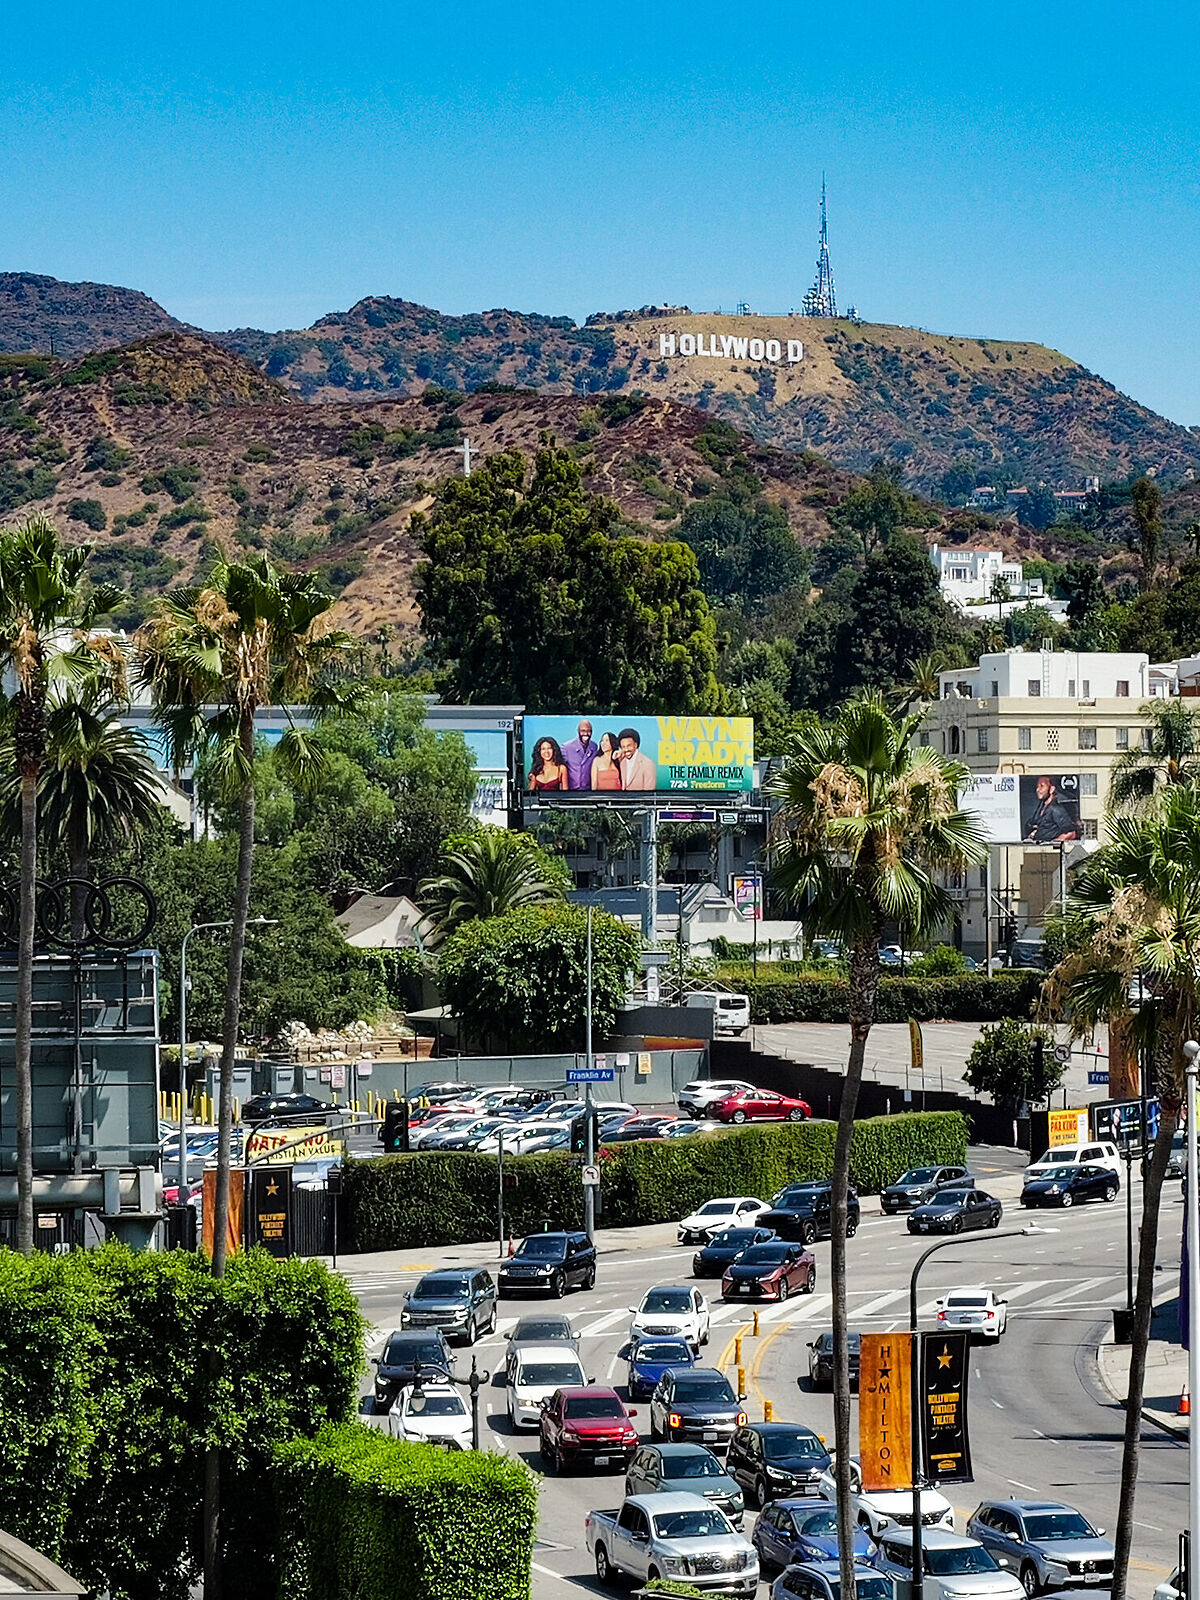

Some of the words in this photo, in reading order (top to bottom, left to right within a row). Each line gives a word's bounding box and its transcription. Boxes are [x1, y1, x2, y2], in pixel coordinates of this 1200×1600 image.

[659, 333, 804, 363] HOLLYWOOD
[497, 720, 512, 729] 192
[656, 715, 754, 741] WAYNE
[669, 766, 685, 779] THE
[687, 766, 716, 779] FAMILY
[717, 766, 744, 779] REMIX
[670, 780, 688, 789] 7/24
[1001, 776, 1015, 784] JOHN
[994, 783, 1015, 792] LEGEND
[569, 1071, 599, 1080] Franklin
[601, 1070, 611, 1079] Av
[1050, 1119, 1077, 1132] PARKING
[308, 1144, 336, 1156] VALUE
[928, 1392, 960, 1405] HOLLYWOOD
[930, 1403, 957, 1415] PANTAGES
[932, 1414, 956, 1426] THEATRE
